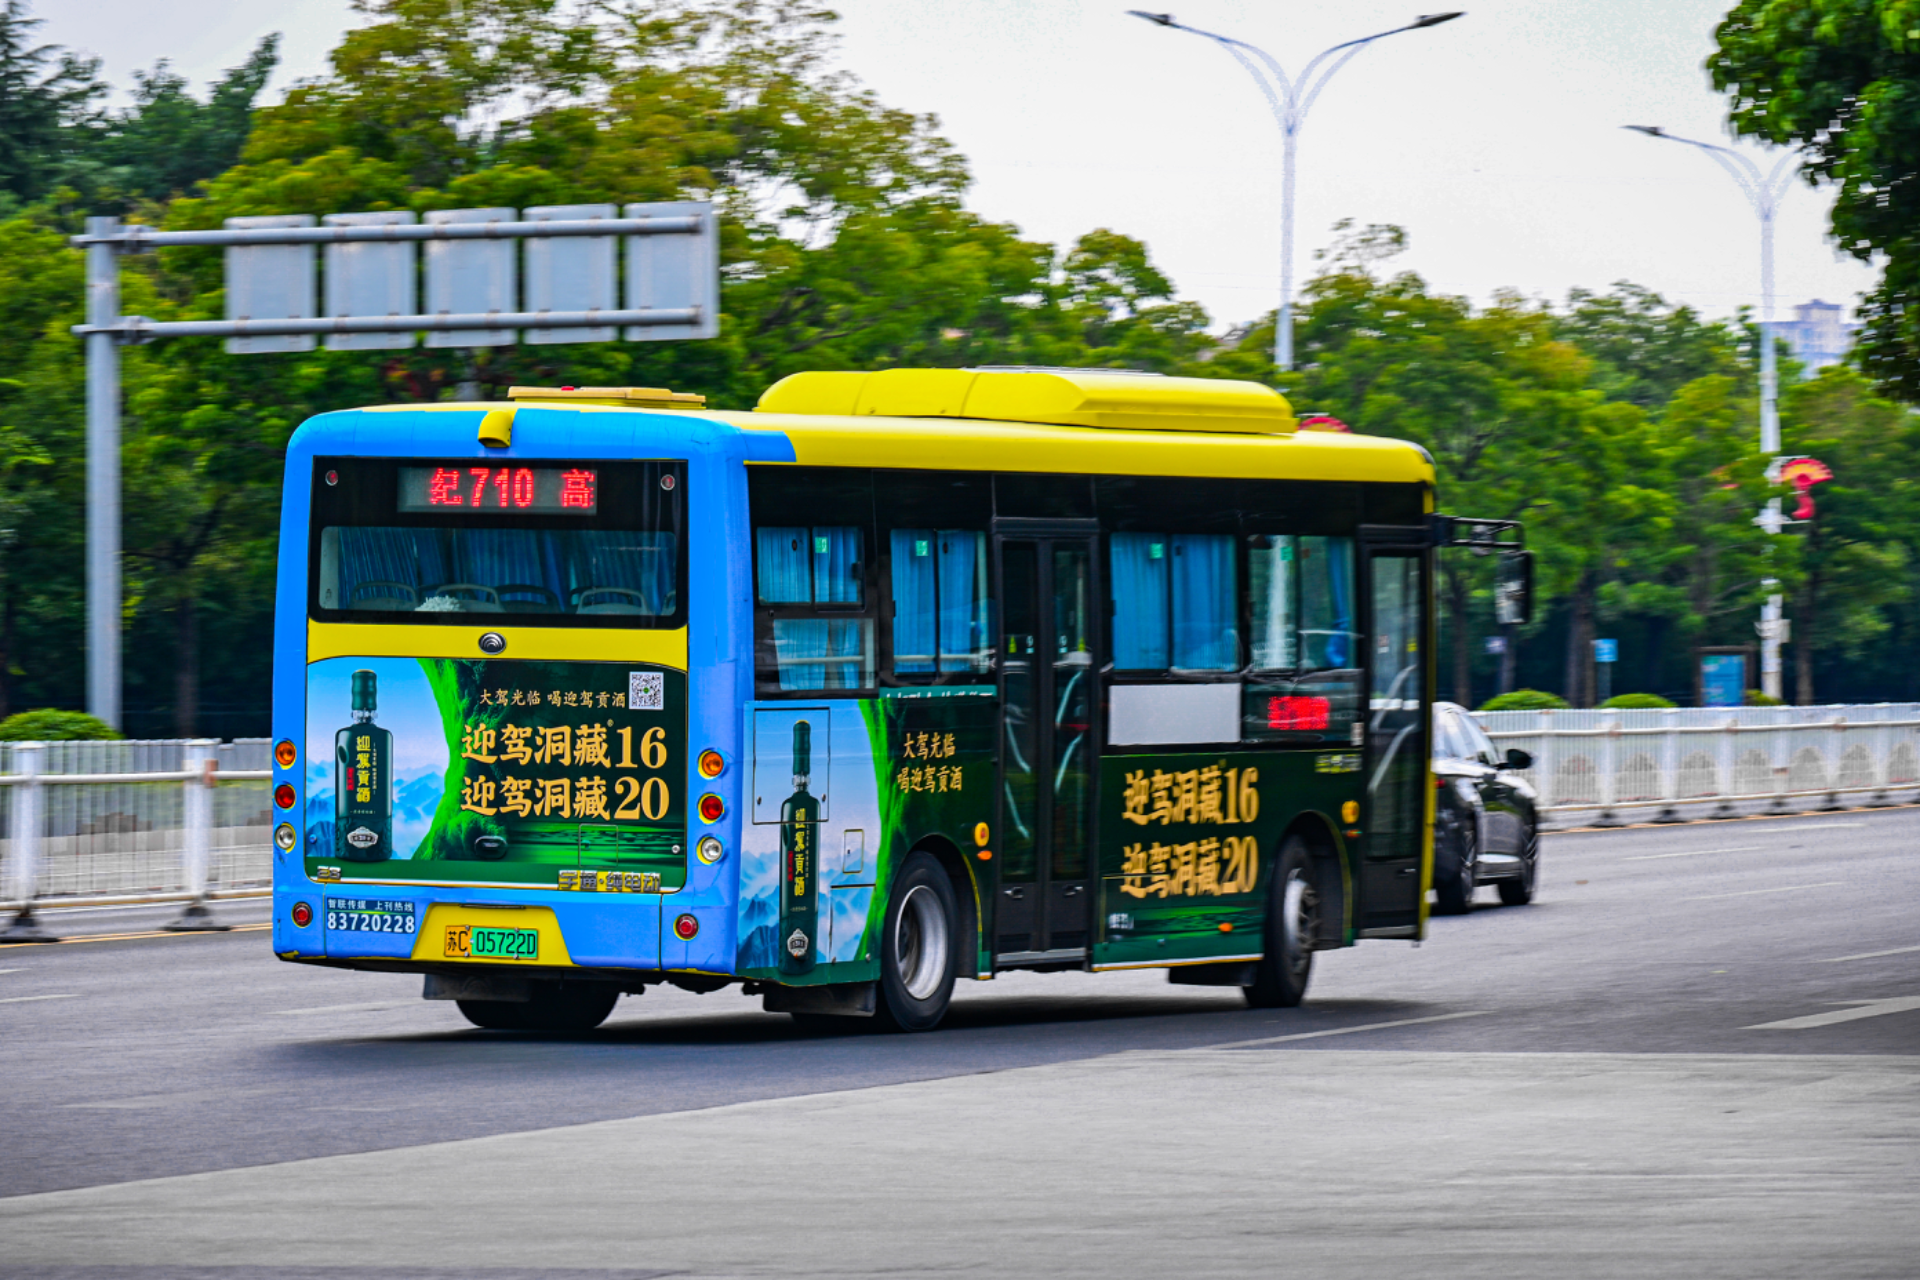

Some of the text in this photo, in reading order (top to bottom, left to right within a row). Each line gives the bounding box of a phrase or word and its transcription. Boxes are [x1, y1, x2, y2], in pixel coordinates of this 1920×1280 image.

[479, 688, 541, 706] 大驾光临
[903, 730, 956, 760] 大驾光临
[327, 912, 415, 933] 83720228
